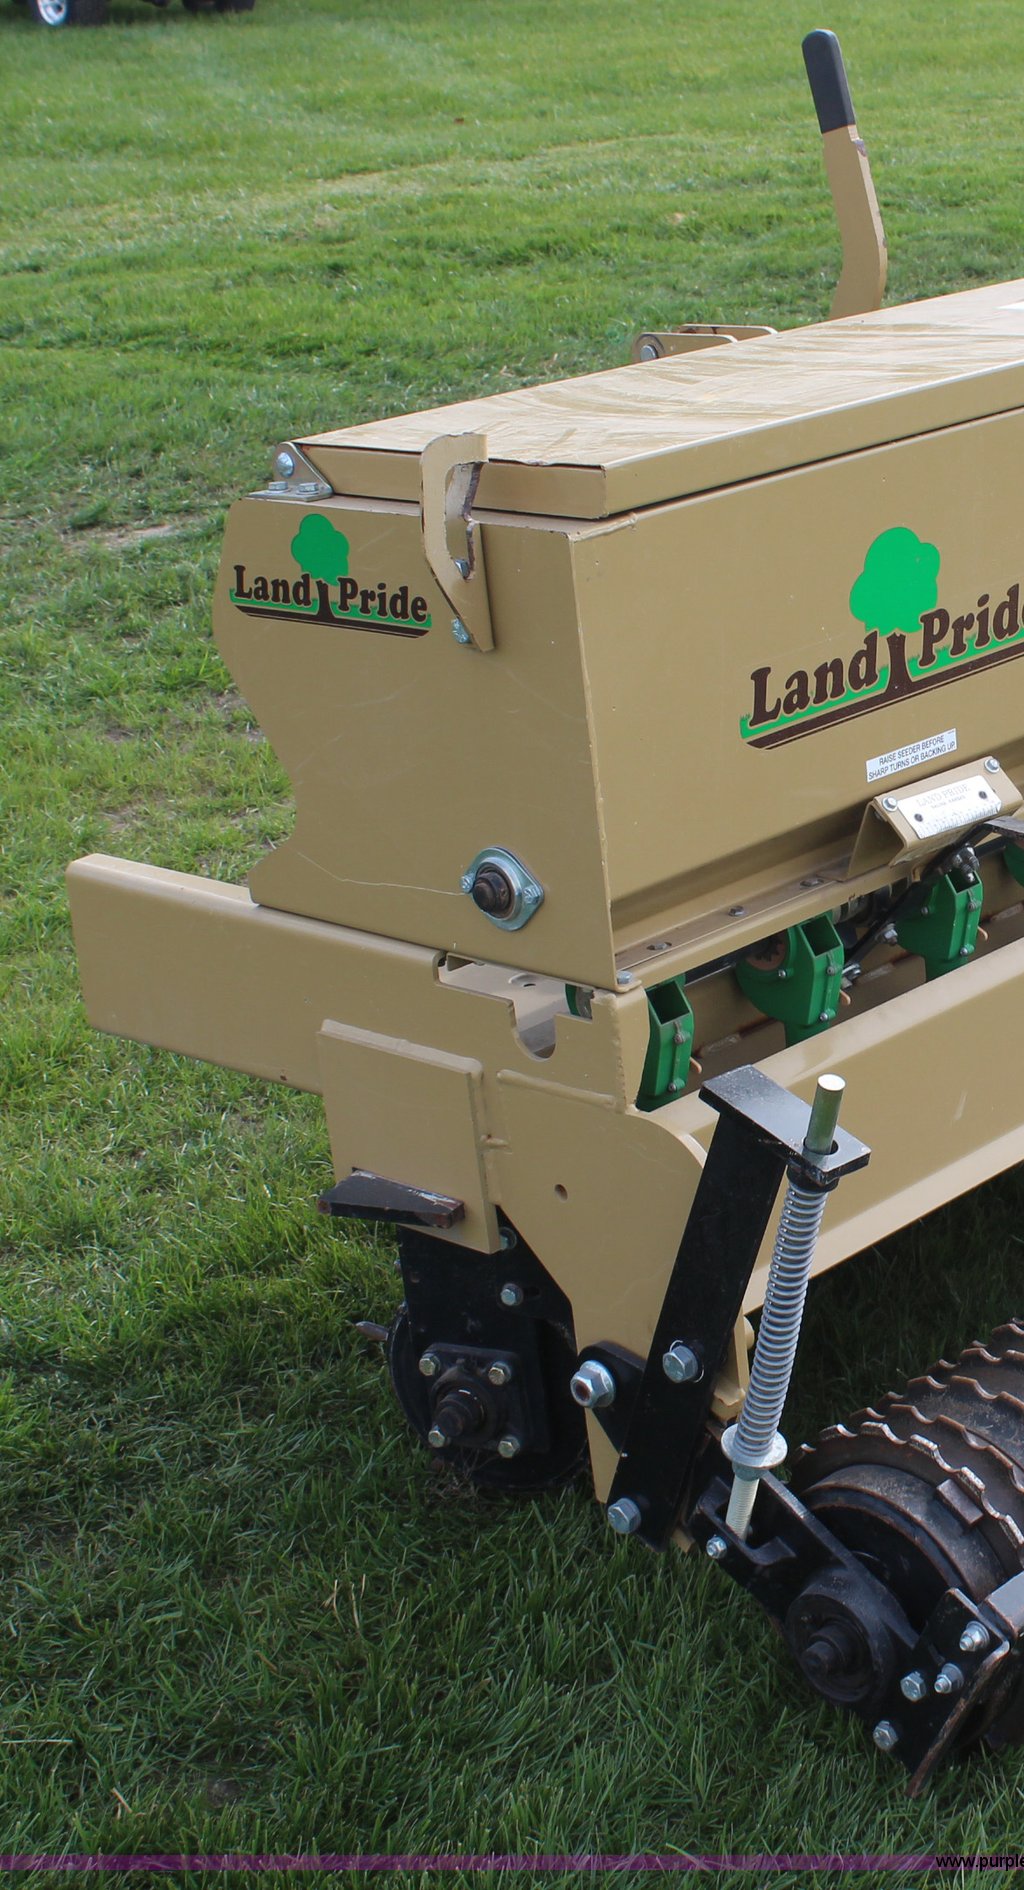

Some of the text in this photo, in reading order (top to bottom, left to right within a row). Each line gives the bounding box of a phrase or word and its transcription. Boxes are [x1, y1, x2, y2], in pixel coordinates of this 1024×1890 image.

[233, 565, 428, 622] Land Pride
[749, 630, 879, 727] Land
[868, 766, 889, 780] SHARP
[890, 759, 910, 772] TURNS
[911, 754, 920, 764] OR
[920, 745, 946, 760] BACKING
[879, 735, 944, 766] RAISE SEEDER BEFORE
[915, 783, 970, 807] LAND PRIDE
